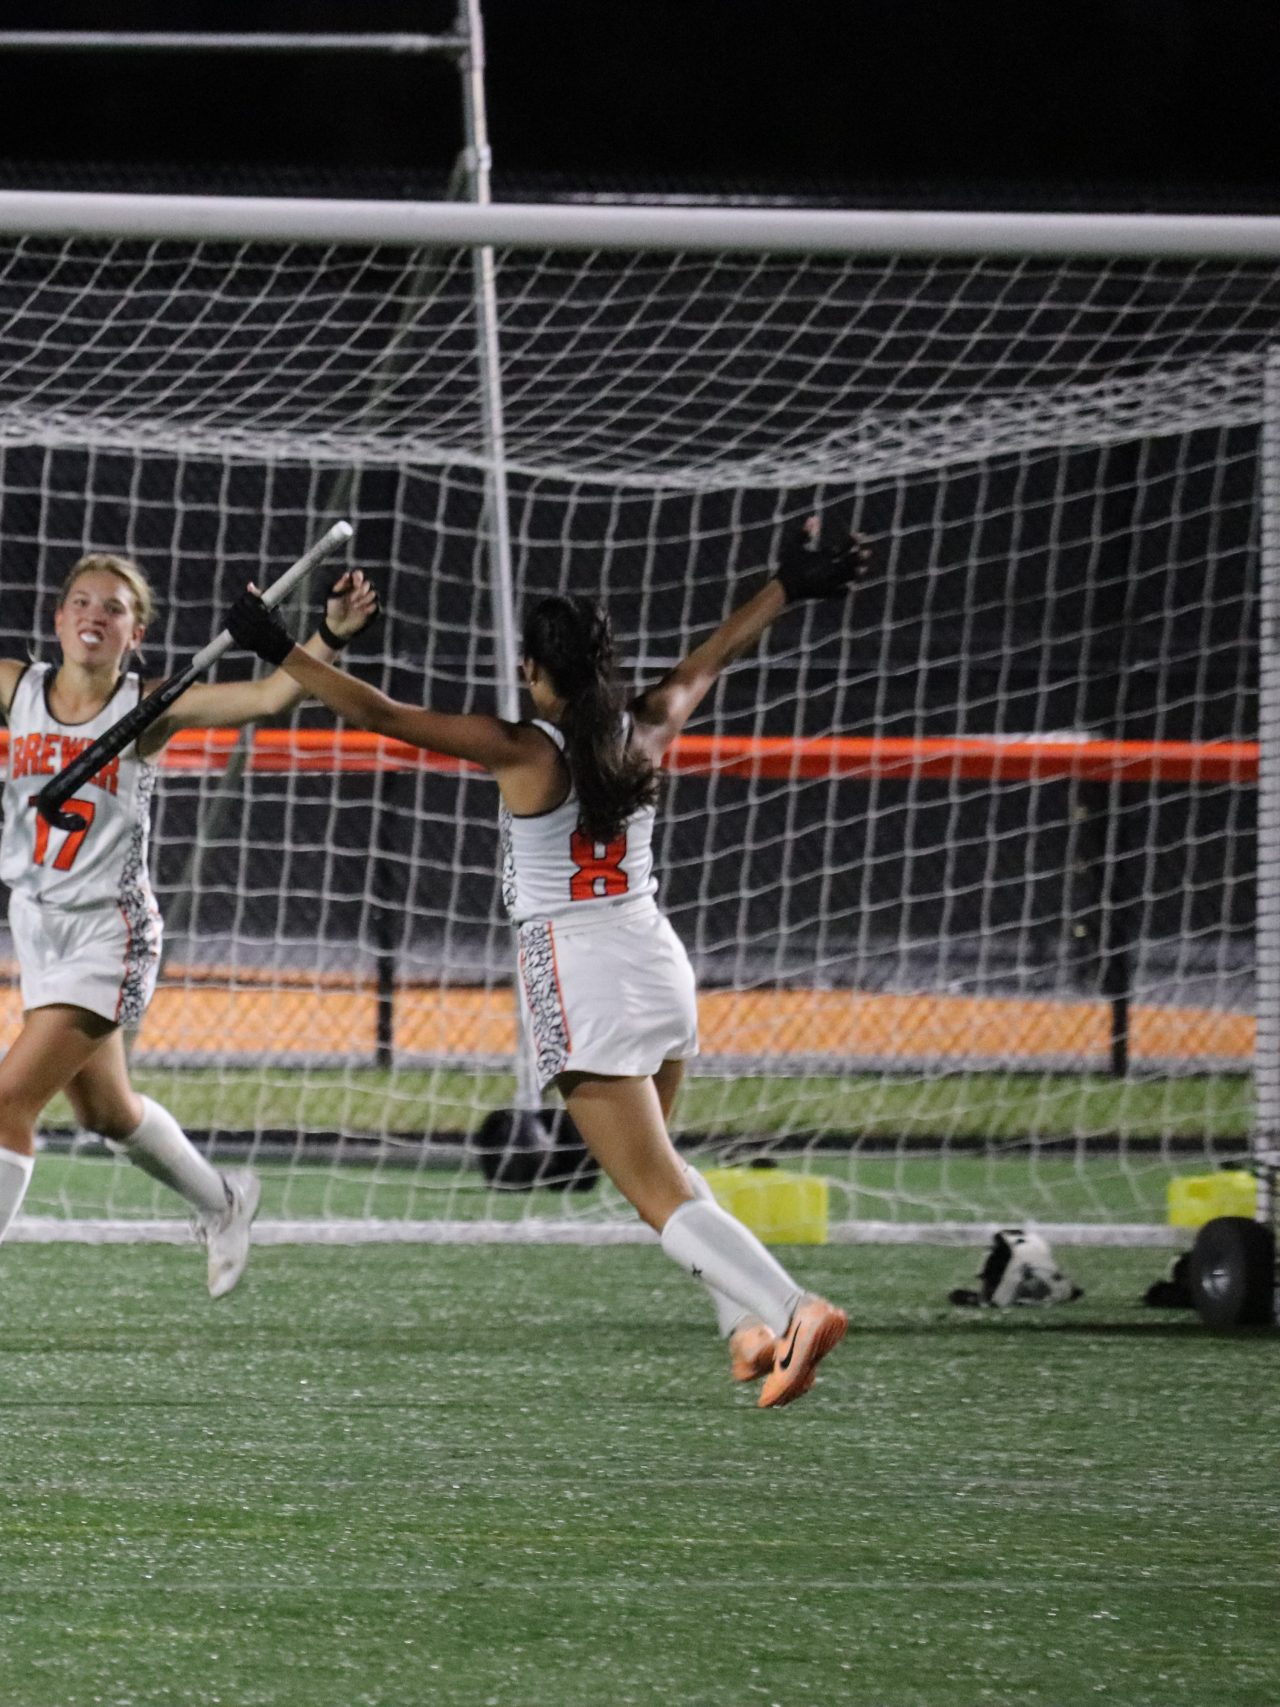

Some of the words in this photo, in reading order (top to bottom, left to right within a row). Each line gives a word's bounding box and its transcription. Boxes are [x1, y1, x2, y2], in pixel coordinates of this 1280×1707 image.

[13, 733, 120, 796] BREWR
[28, 796, 96, 871] 17
[570, 825, 629, 901] 8
